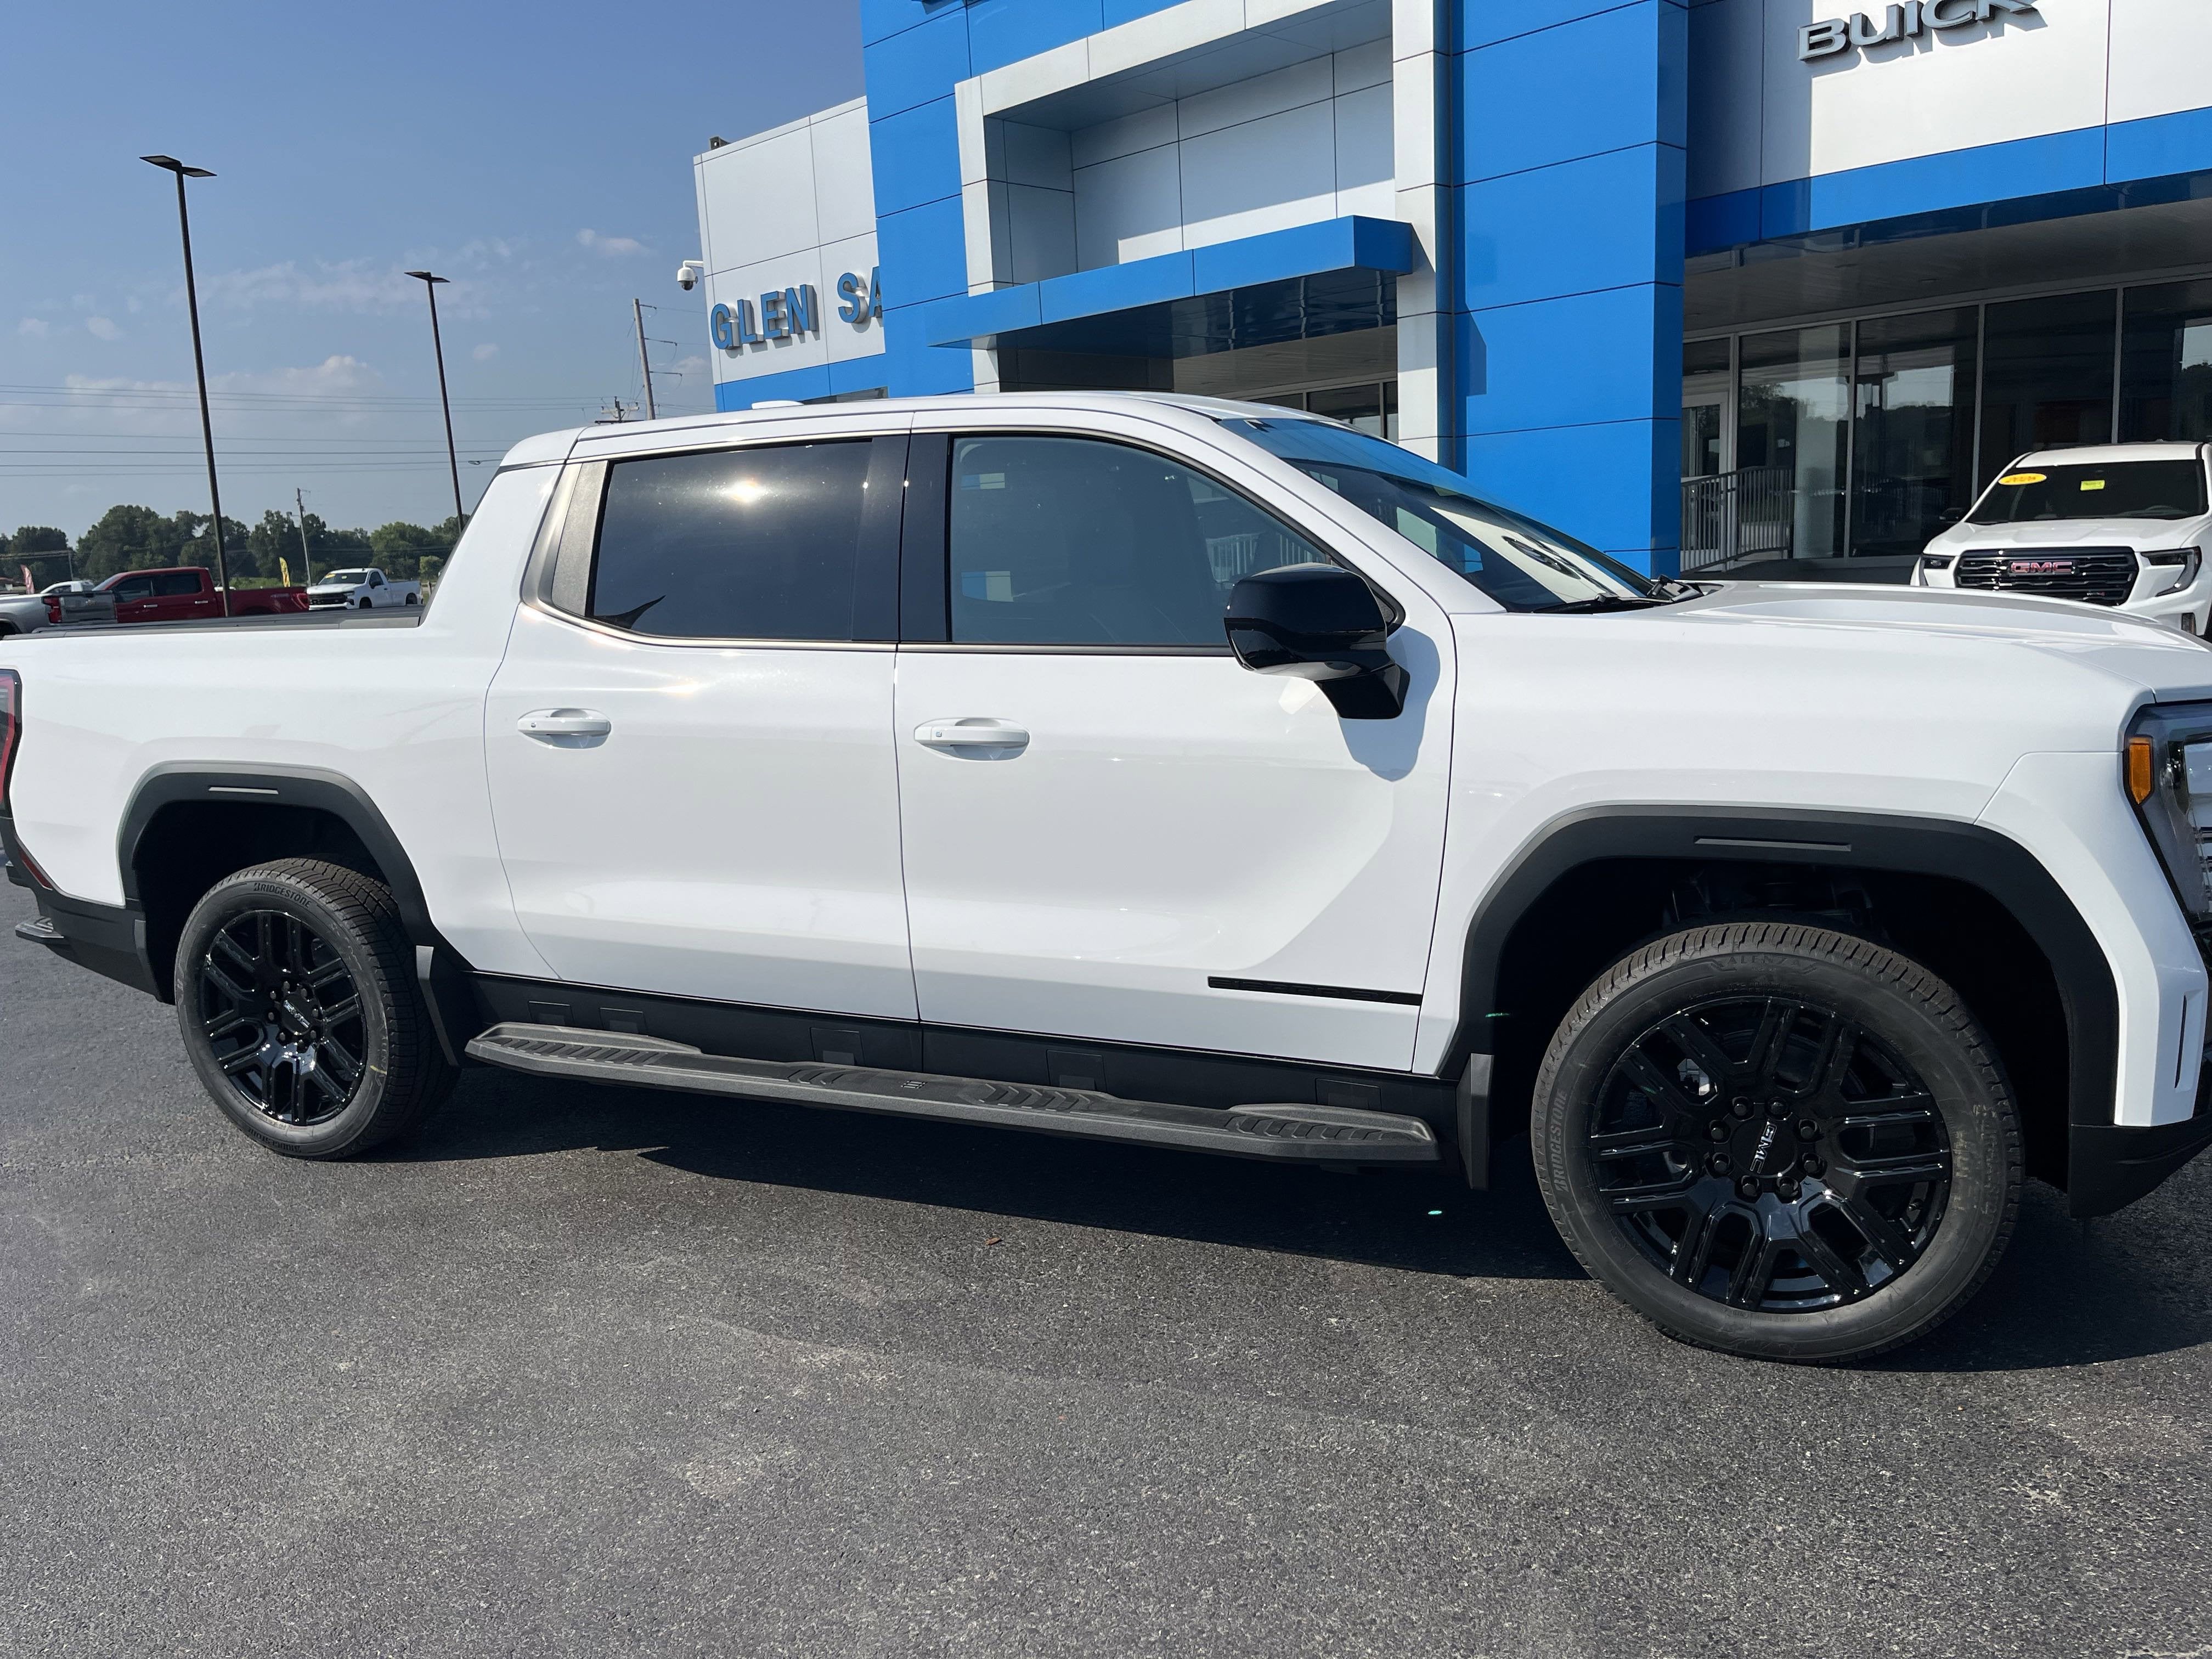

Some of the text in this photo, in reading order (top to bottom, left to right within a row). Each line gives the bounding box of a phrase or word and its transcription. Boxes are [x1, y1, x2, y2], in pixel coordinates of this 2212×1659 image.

[710, 284, 816, 349] GLEN
[2011, 561, 2073, 574] GMC
[253, 882, 312, 909] BRIDGESTONE
[283, 1000, 311, 1029] GMC
[1553, 1088, 1570, 1193] BRIDGESTONE
[1750, 1120, 1778, 1174] GMC
